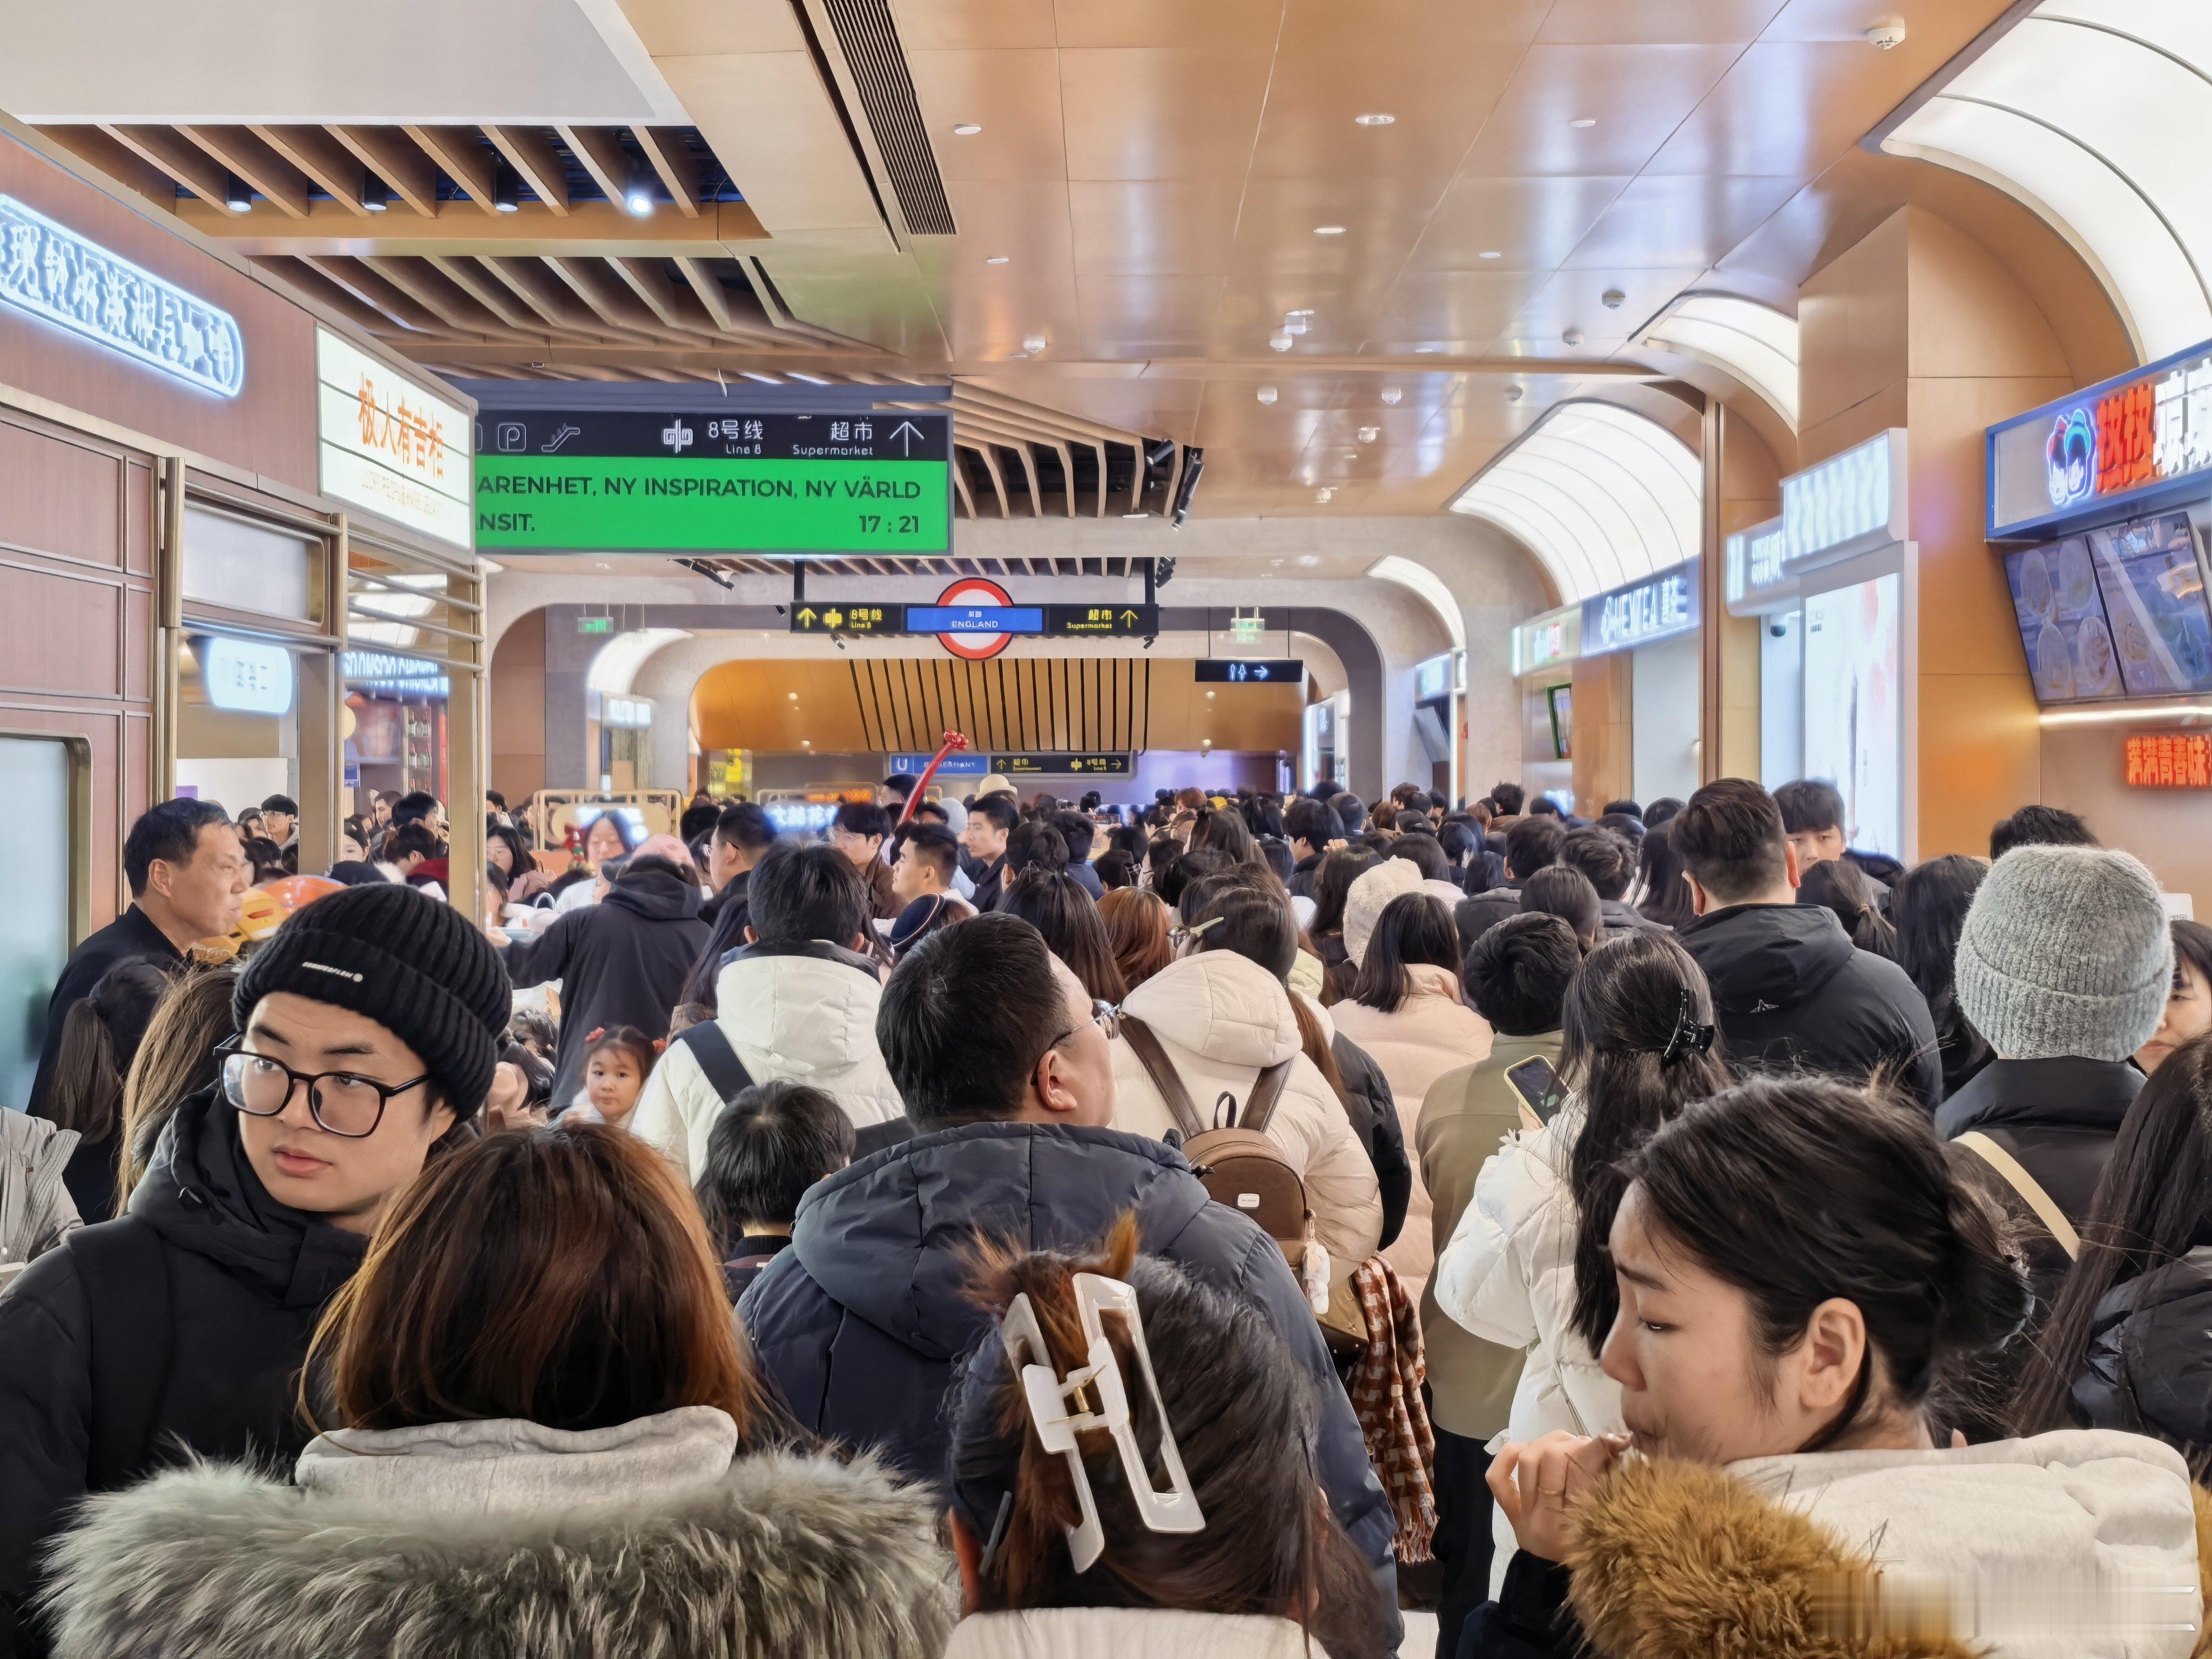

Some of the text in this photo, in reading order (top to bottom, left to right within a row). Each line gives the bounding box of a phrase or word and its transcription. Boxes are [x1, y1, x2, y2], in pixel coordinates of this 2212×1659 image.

[708, 419, 764, 441] 8号线
[830, 418, 873, 441] 超市
[725, 444, 751, 455] Line
[792, 444, 874, 457] Supermarket
[604, 477, 638, 496] NY
[644, 477, 798, 500] INSPIRATION,
[805, 479, 838, 498] NY
[844, 476, 921, 500] VÄRLD
[477, 512, 536, 532] NSIT.
[896, 757, 908, 772] U
[940, 760, 976, 768] ERMANY
